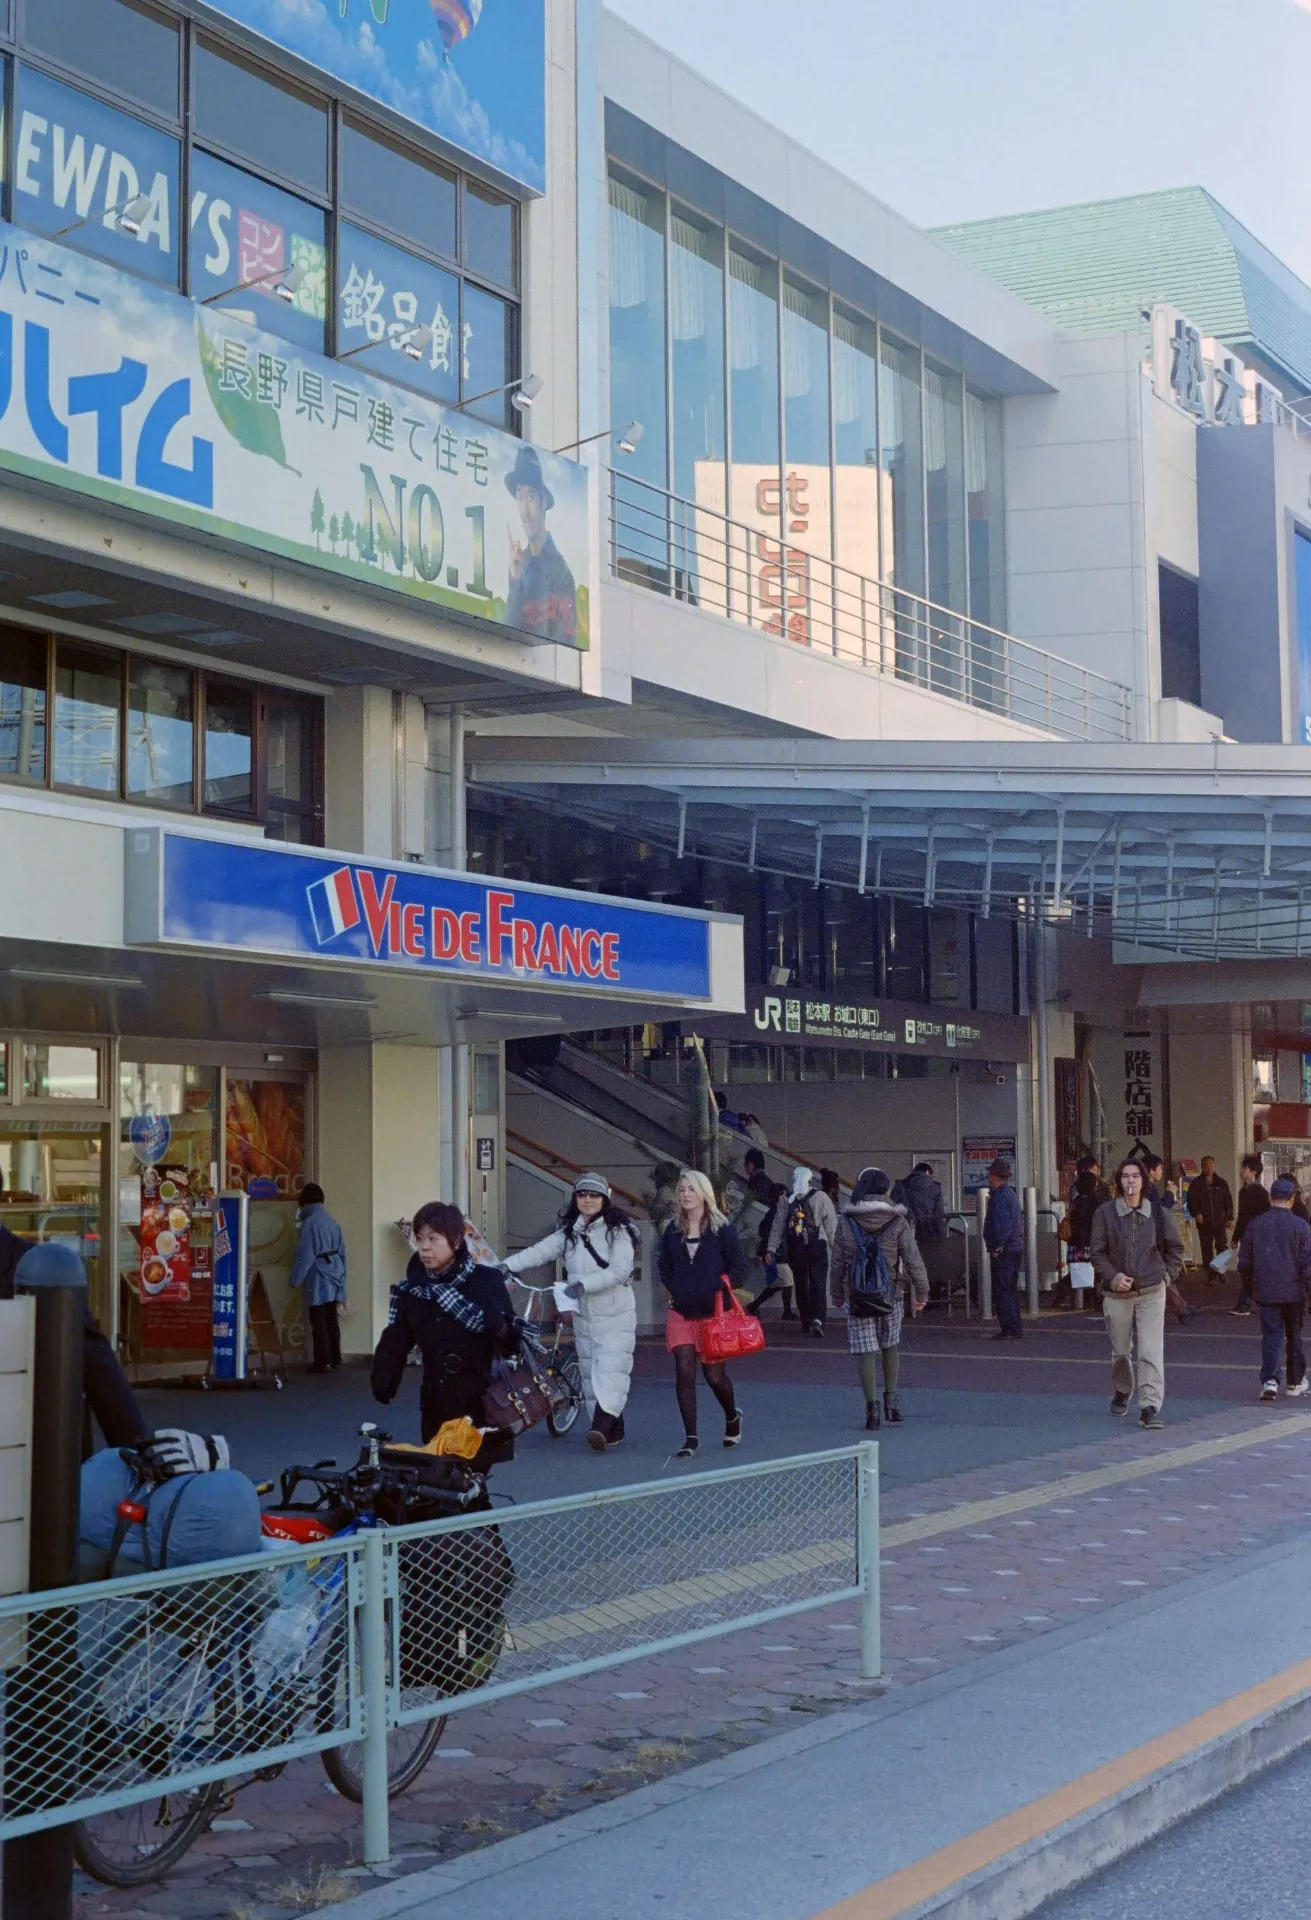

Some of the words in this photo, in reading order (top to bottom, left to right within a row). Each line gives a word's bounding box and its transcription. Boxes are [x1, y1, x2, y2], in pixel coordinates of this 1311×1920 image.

[218, 338, 490, 487] 長野県戸建て住宅
[359, 462, 493, 599] NO.1
[754, 996, 782, 1032] JR
[805, 1001, 831, 1022] 松本駅
[805, 1023, 833, 1037] Matsumoto
[843, 1027, 859, 1039] Castle
[859, 1029, 871, 1041] Gate
